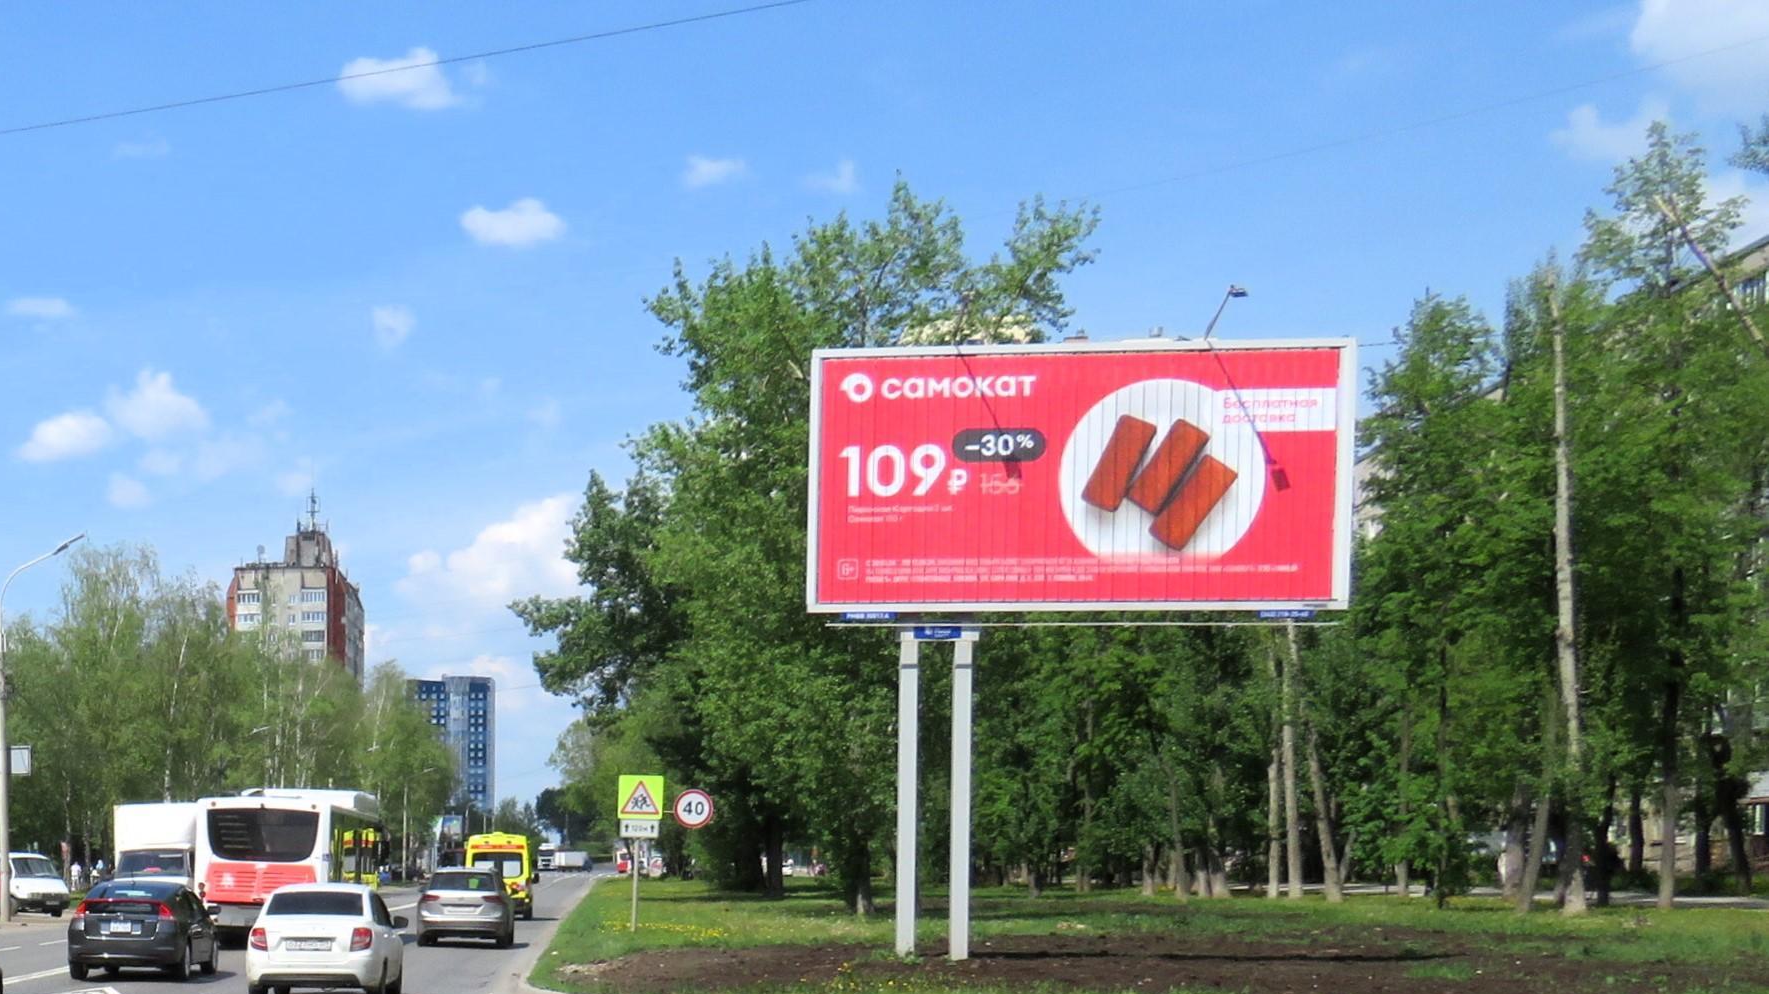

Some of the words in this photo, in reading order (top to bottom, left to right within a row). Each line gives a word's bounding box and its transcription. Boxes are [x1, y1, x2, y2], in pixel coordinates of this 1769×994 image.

[881, 375, 1037, 399] самокат
[965, 433, 1035, 456] -30%
[683, 801, 705, 815] 40
